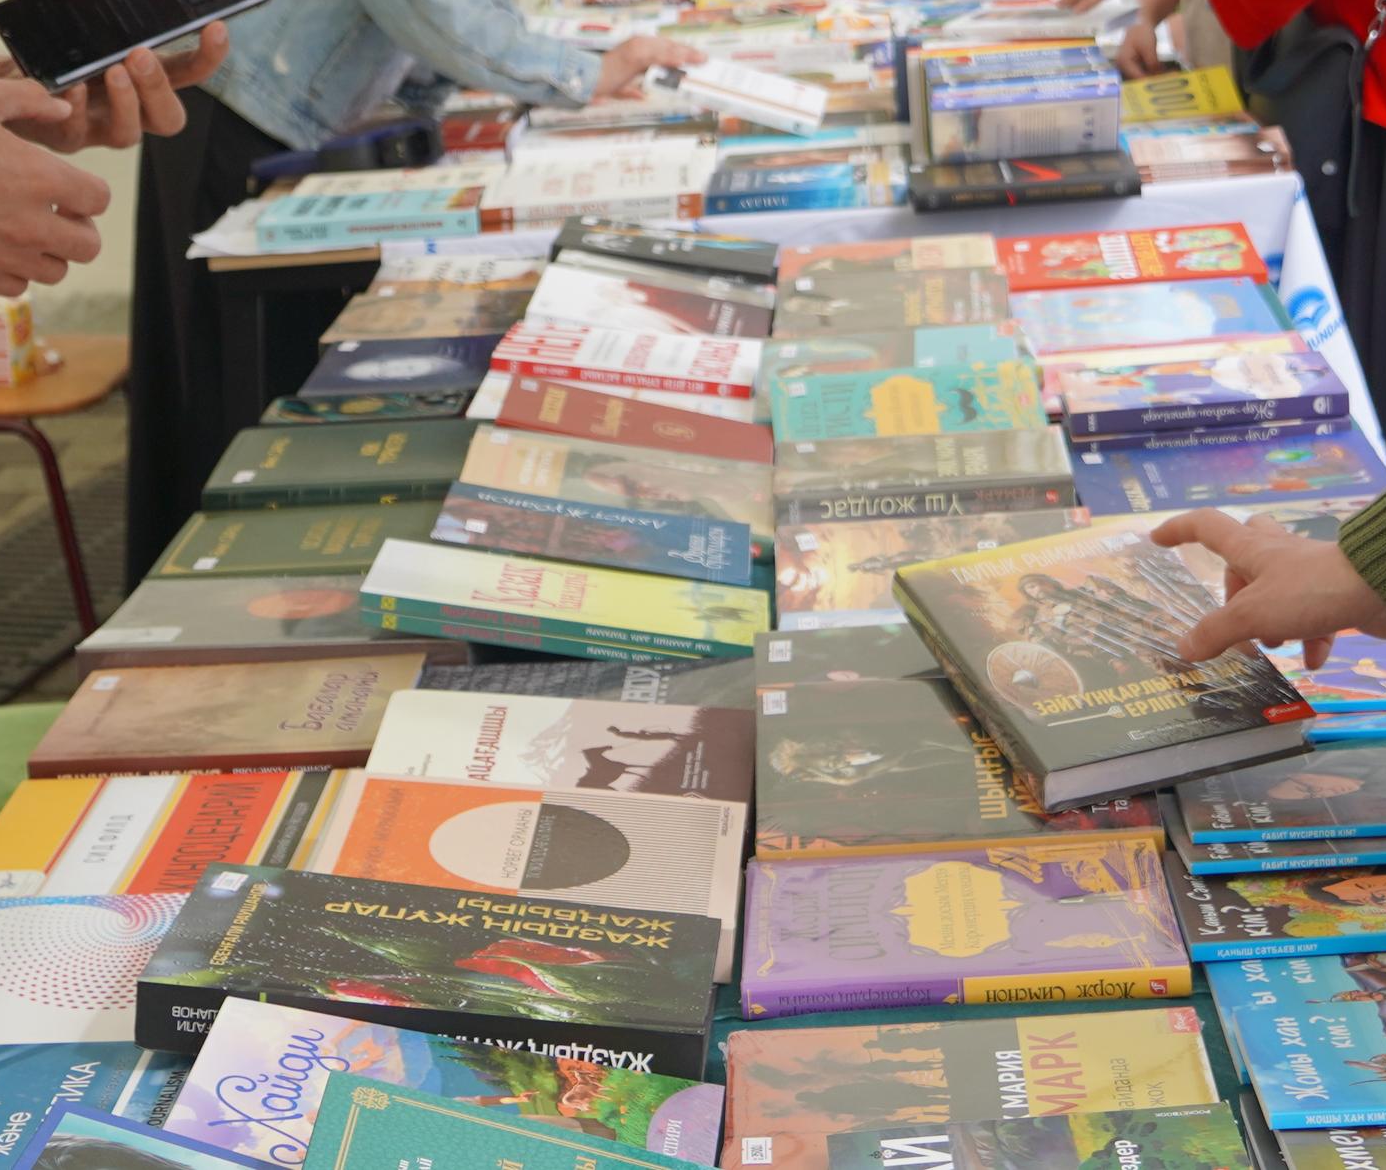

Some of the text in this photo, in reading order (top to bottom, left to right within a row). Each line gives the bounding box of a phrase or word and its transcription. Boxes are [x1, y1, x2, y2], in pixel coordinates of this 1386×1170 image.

[324, 899, 673, 949] ЖАЗДЫҢ ЖҰПАР
[456, 896, 676, 932] ЖАҢБЫРЫ
[1242, 960, 1270, 983] ха
[1281, 958, 1315, 984] кім
[1273, 1016, 1297, 1049] хан
[995, 1050, 1028, 1109] МАРИЯ
[1026, 1031, 1088, 1115] МАРК
[1109, 1057, 1135, 1111] айданда
[147, 1070, 188, 1128] OURNALISM
[663, 1118, 684, 1158] СПИРИ
[1305, 1115, 1342, 1126] ЖОШЫ
[1343, 1113, 1364, 1124] ХАН
